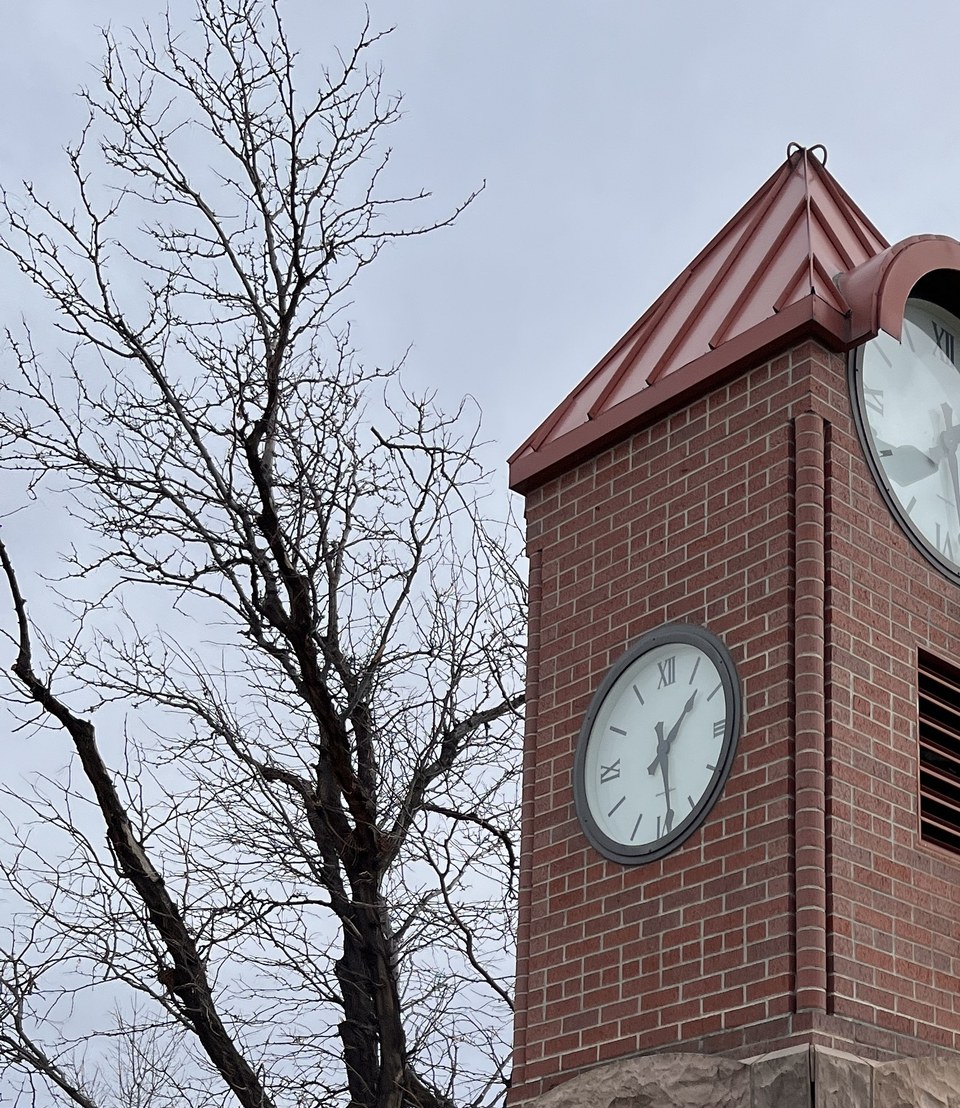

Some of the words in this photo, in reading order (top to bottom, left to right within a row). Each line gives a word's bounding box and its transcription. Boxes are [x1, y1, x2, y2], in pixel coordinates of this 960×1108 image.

[932, 321, 954, 365] XII
[657, 656, 675, 689] XII
[713, 719, 726, 738] III
